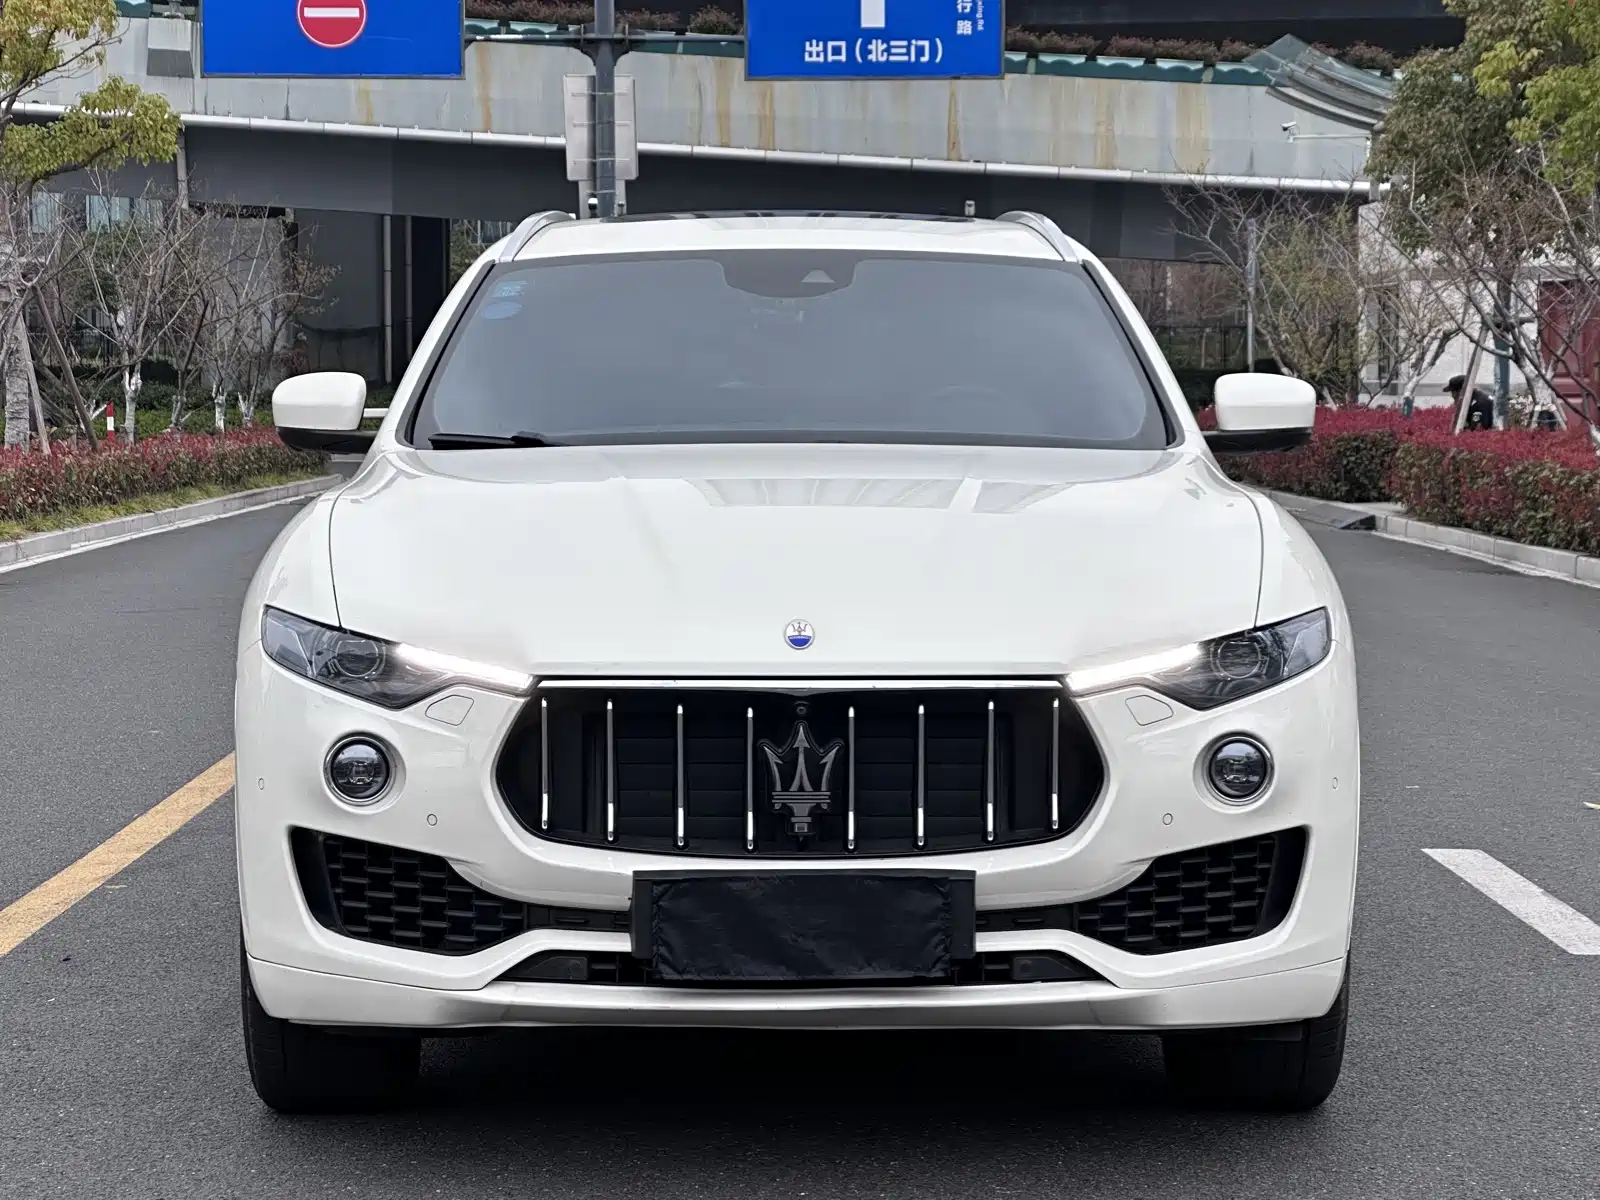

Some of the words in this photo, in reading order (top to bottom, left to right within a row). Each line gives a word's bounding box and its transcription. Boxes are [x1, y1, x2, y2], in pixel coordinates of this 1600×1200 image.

[976, 19, 985, 31] Rd
[804, 38, 943, 63] 出口（北三门）
